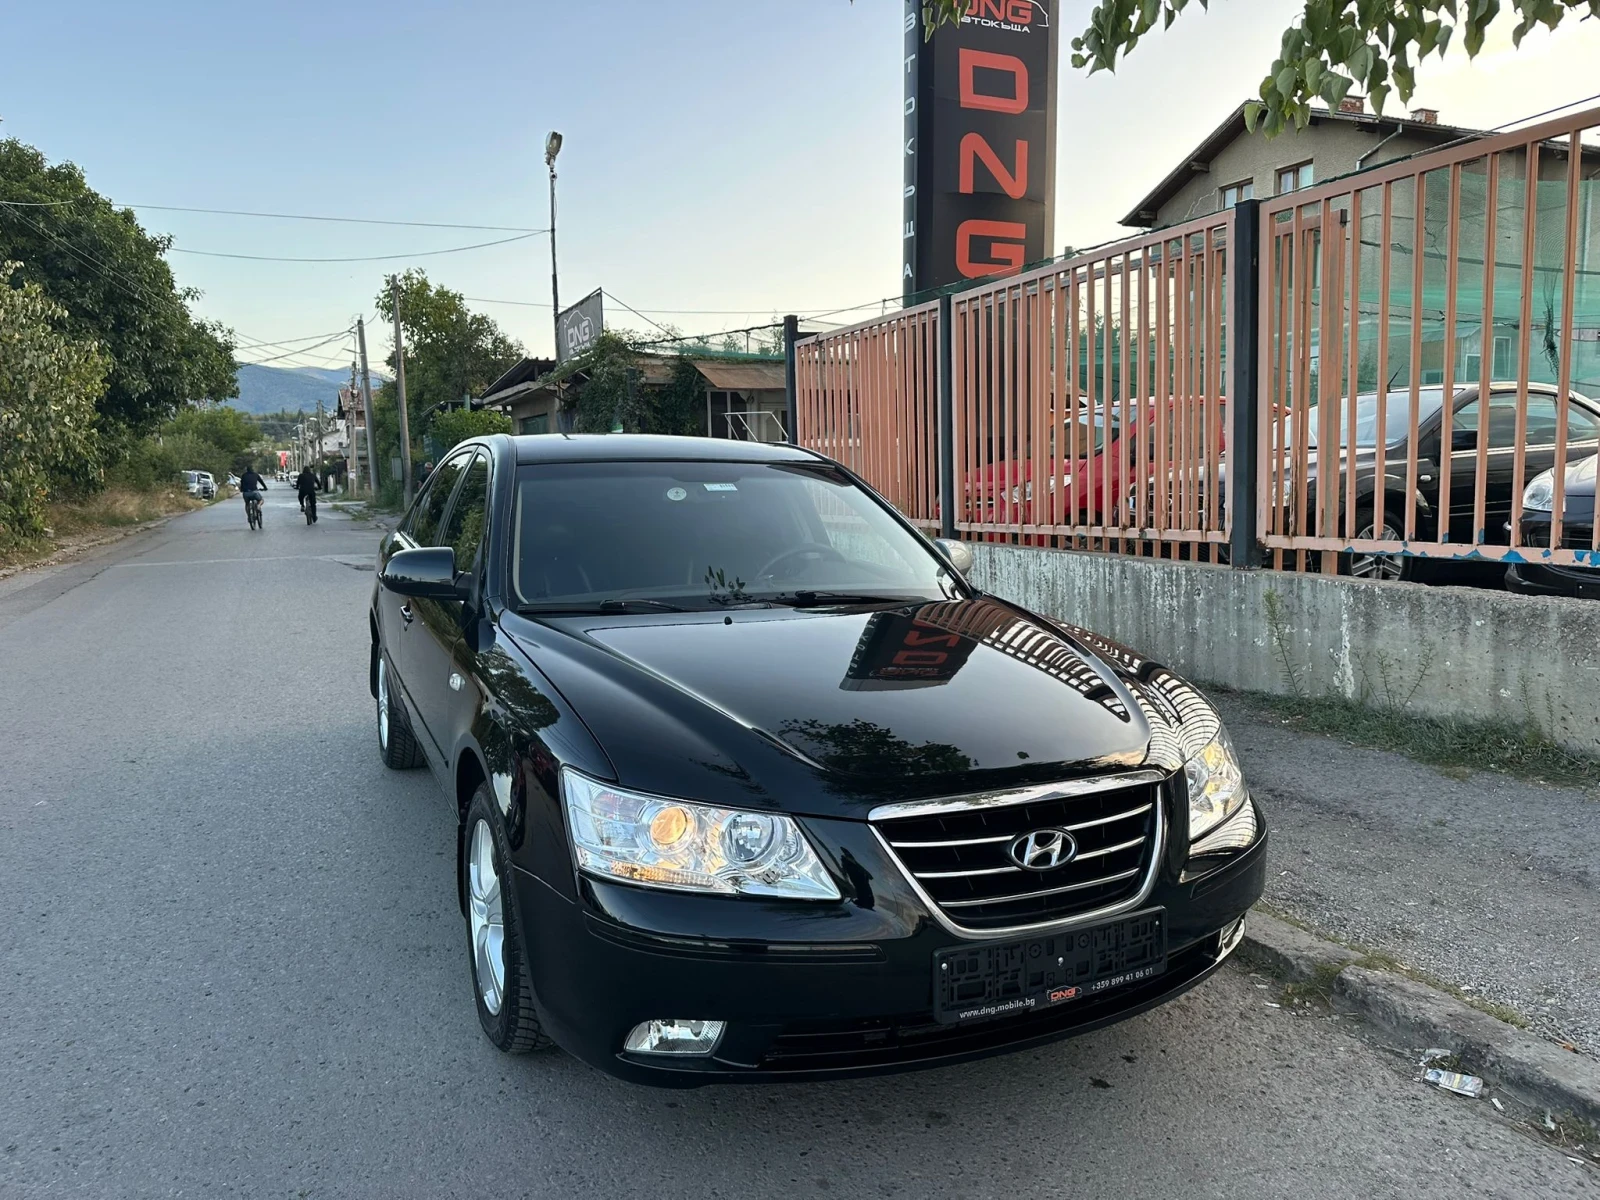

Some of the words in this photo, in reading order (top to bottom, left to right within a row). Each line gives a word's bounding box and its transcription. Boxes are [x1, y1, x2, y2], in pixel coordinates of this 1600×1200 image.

[959, 15, 1031, 34] ВТОКЪЩА
[903, 0, 917, 280] ВТОКЪЩА
[956, 47, 1029, 280] DNG
[567, 320, 590, 348] DNG
[1091, 979, 1110, 991] +359
[1111, 975, 1125, 986] 899
[1125, 972, 1134, 981] 41
[1135, 970, 1145, 979] 06
[1145, 967, 1153, 976] 01
[1050, 987, 1077, 1000] DNG
[959, 997, 1036, 1019] www.dng.mobile.bg
